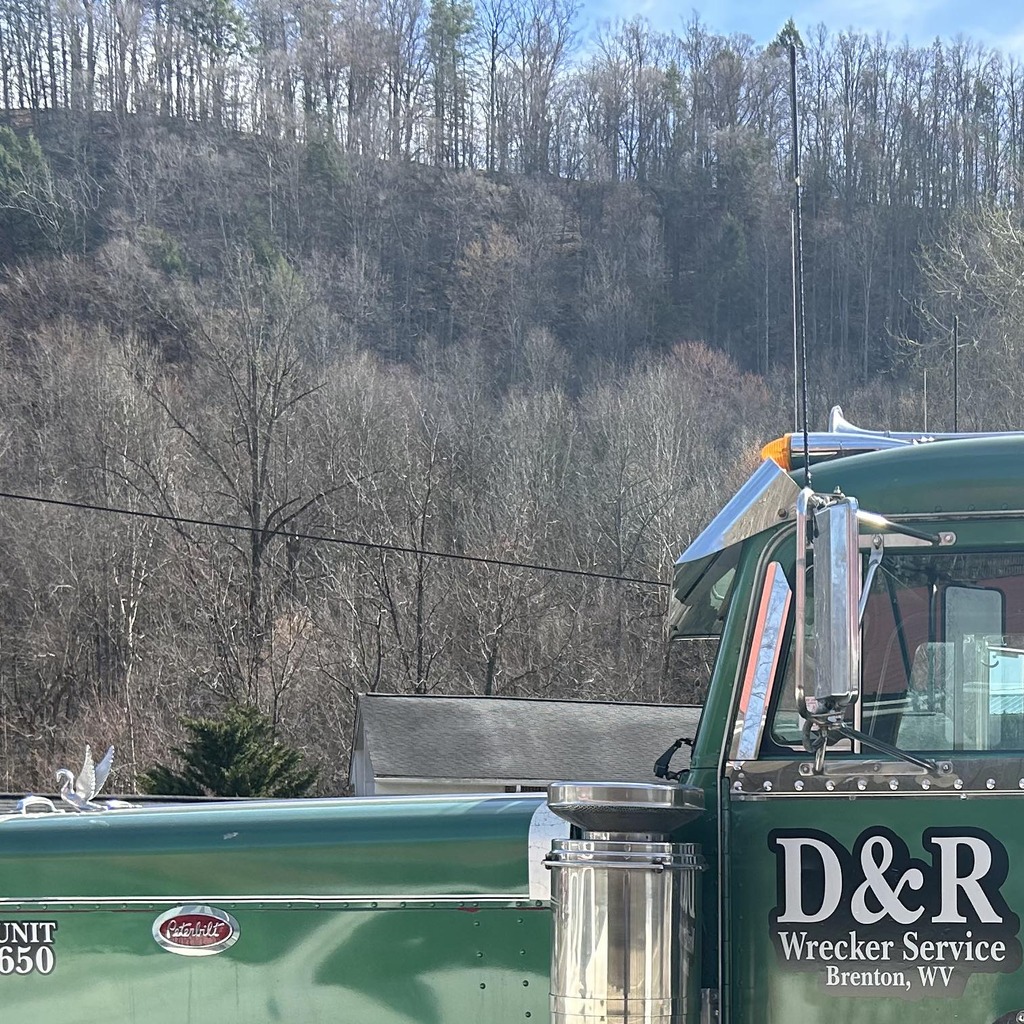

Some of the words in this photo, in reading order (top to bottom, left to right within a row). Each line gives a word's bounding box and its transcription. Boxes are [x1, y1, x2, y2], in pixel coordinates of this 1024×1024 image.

[776, 835, 1003, 925] D&R
[165, 919, 225, 939] Peterbilt
[777, 931, 894, 961] Wrecker
[902, 930, 1006, 961] Service
[0, 946, 54, 974] 650
[826, 965, 911, 990] Brenton,
[917, 965, 955, 987] WV
